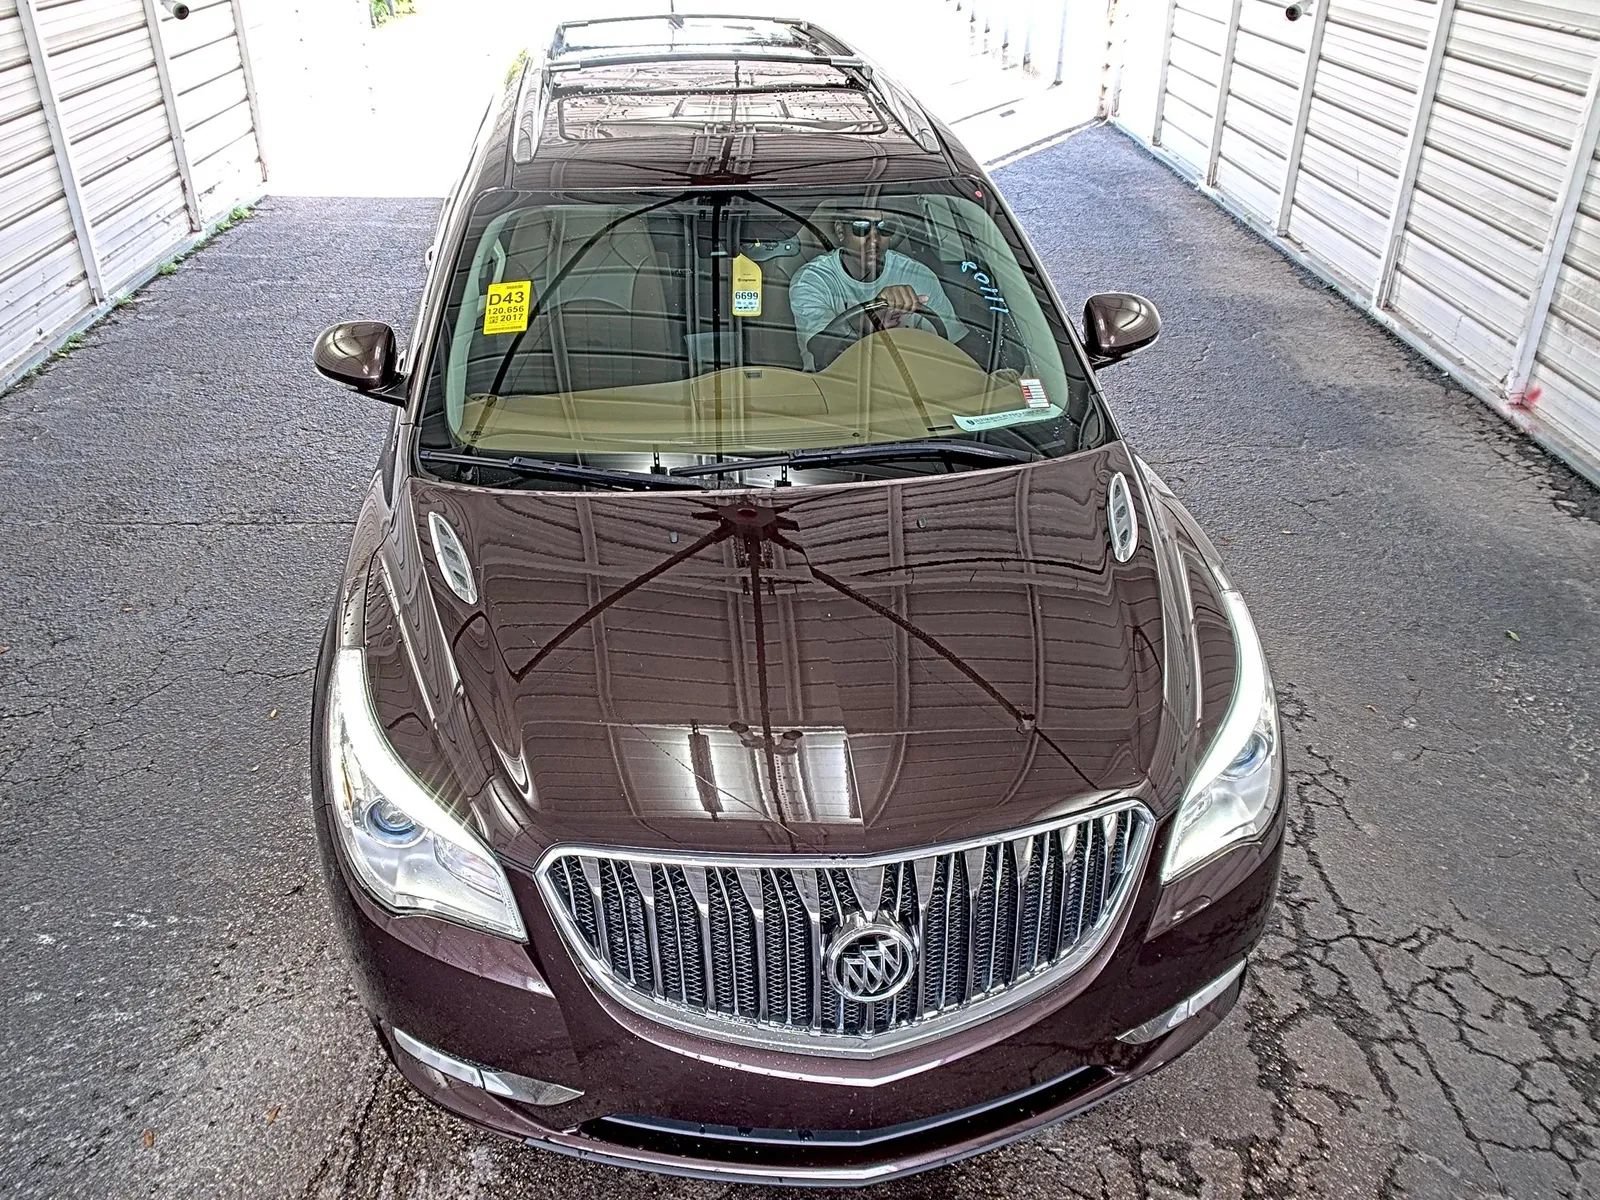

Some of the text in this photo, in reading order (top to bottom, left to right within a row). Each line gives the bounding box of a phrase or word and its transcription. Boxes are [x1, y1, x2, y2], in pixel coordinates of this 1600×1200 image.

[489, 291, 525, 306] D43
[735, 291, 759, 300] 6699
[500, 313, 524, 322] 2017
